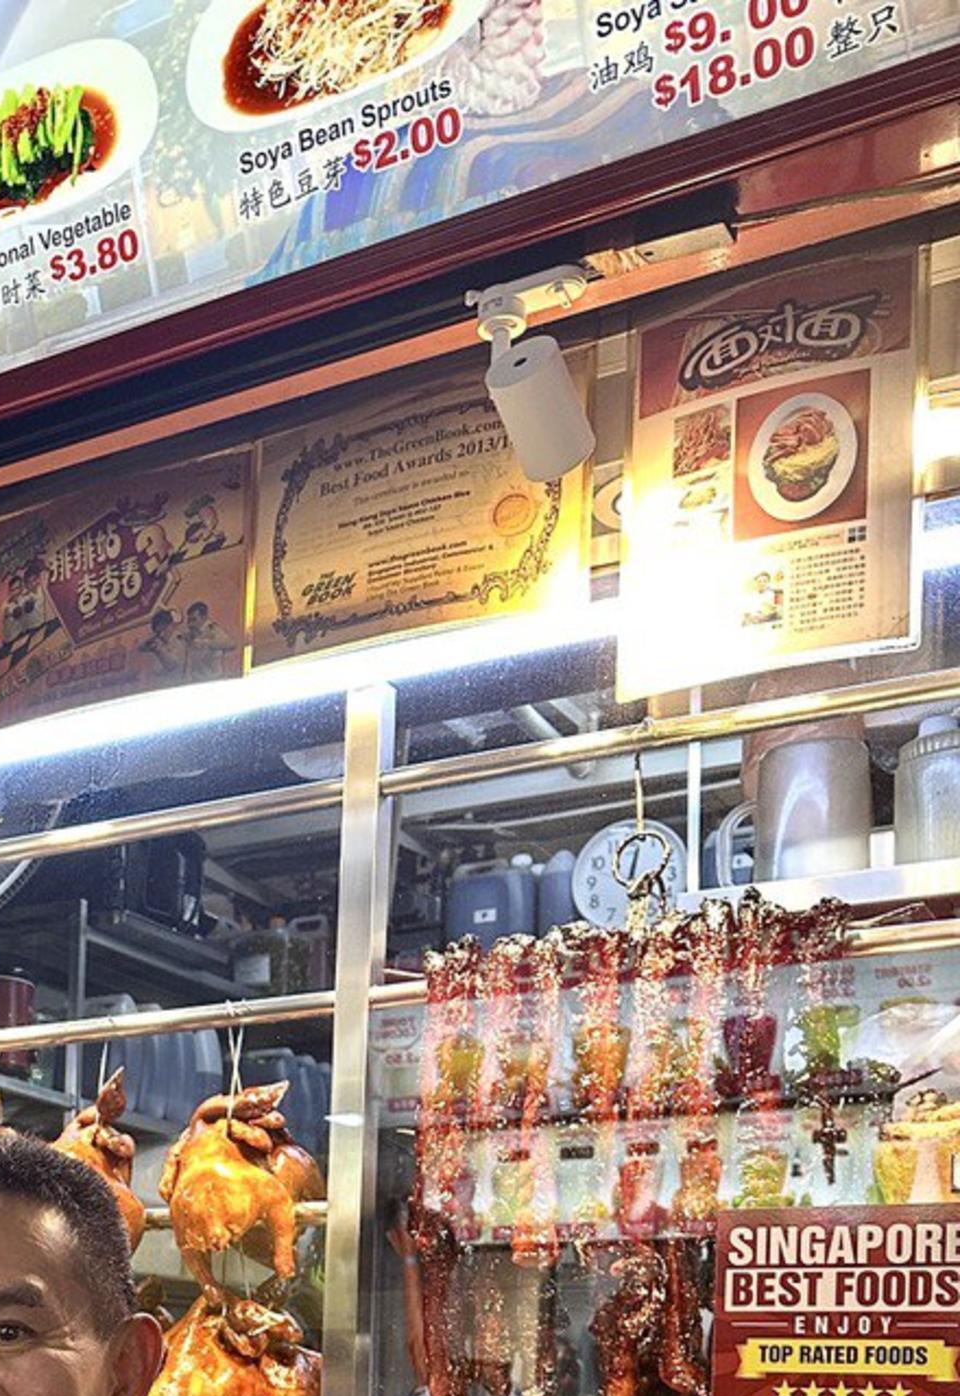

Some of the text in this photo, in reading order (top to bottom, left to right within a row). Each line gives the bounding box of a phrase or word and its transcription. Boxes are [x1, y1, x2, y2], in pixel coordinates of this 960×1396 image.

[596, 0, 663, 38] Soya
[590, 40, 655, 90] 油鸡
[653, 5, 898, 107] $18.00 整只
[240, 79, 452, 175] Soya Bean Sprouts
[239, 106, 461, 220] 特色豆芽 $2.00
[38, 201, 132, 252] Vegetable
[49, 227, 139, 283] $3.80
[319, 434, 514, 498] Best Food Awards 2013/1
[301, 571, 357, 598] GREEN
[306, 583, 356, 607] BOOK
[728, 1223, 960, 1266] SINGAPORE
[731, 1270, 959, 1307] BEST FOODS
[794, 1315, 892, 1335] ENJOY
[759, 1344, 928, 1366] TOP RATED FOODS
